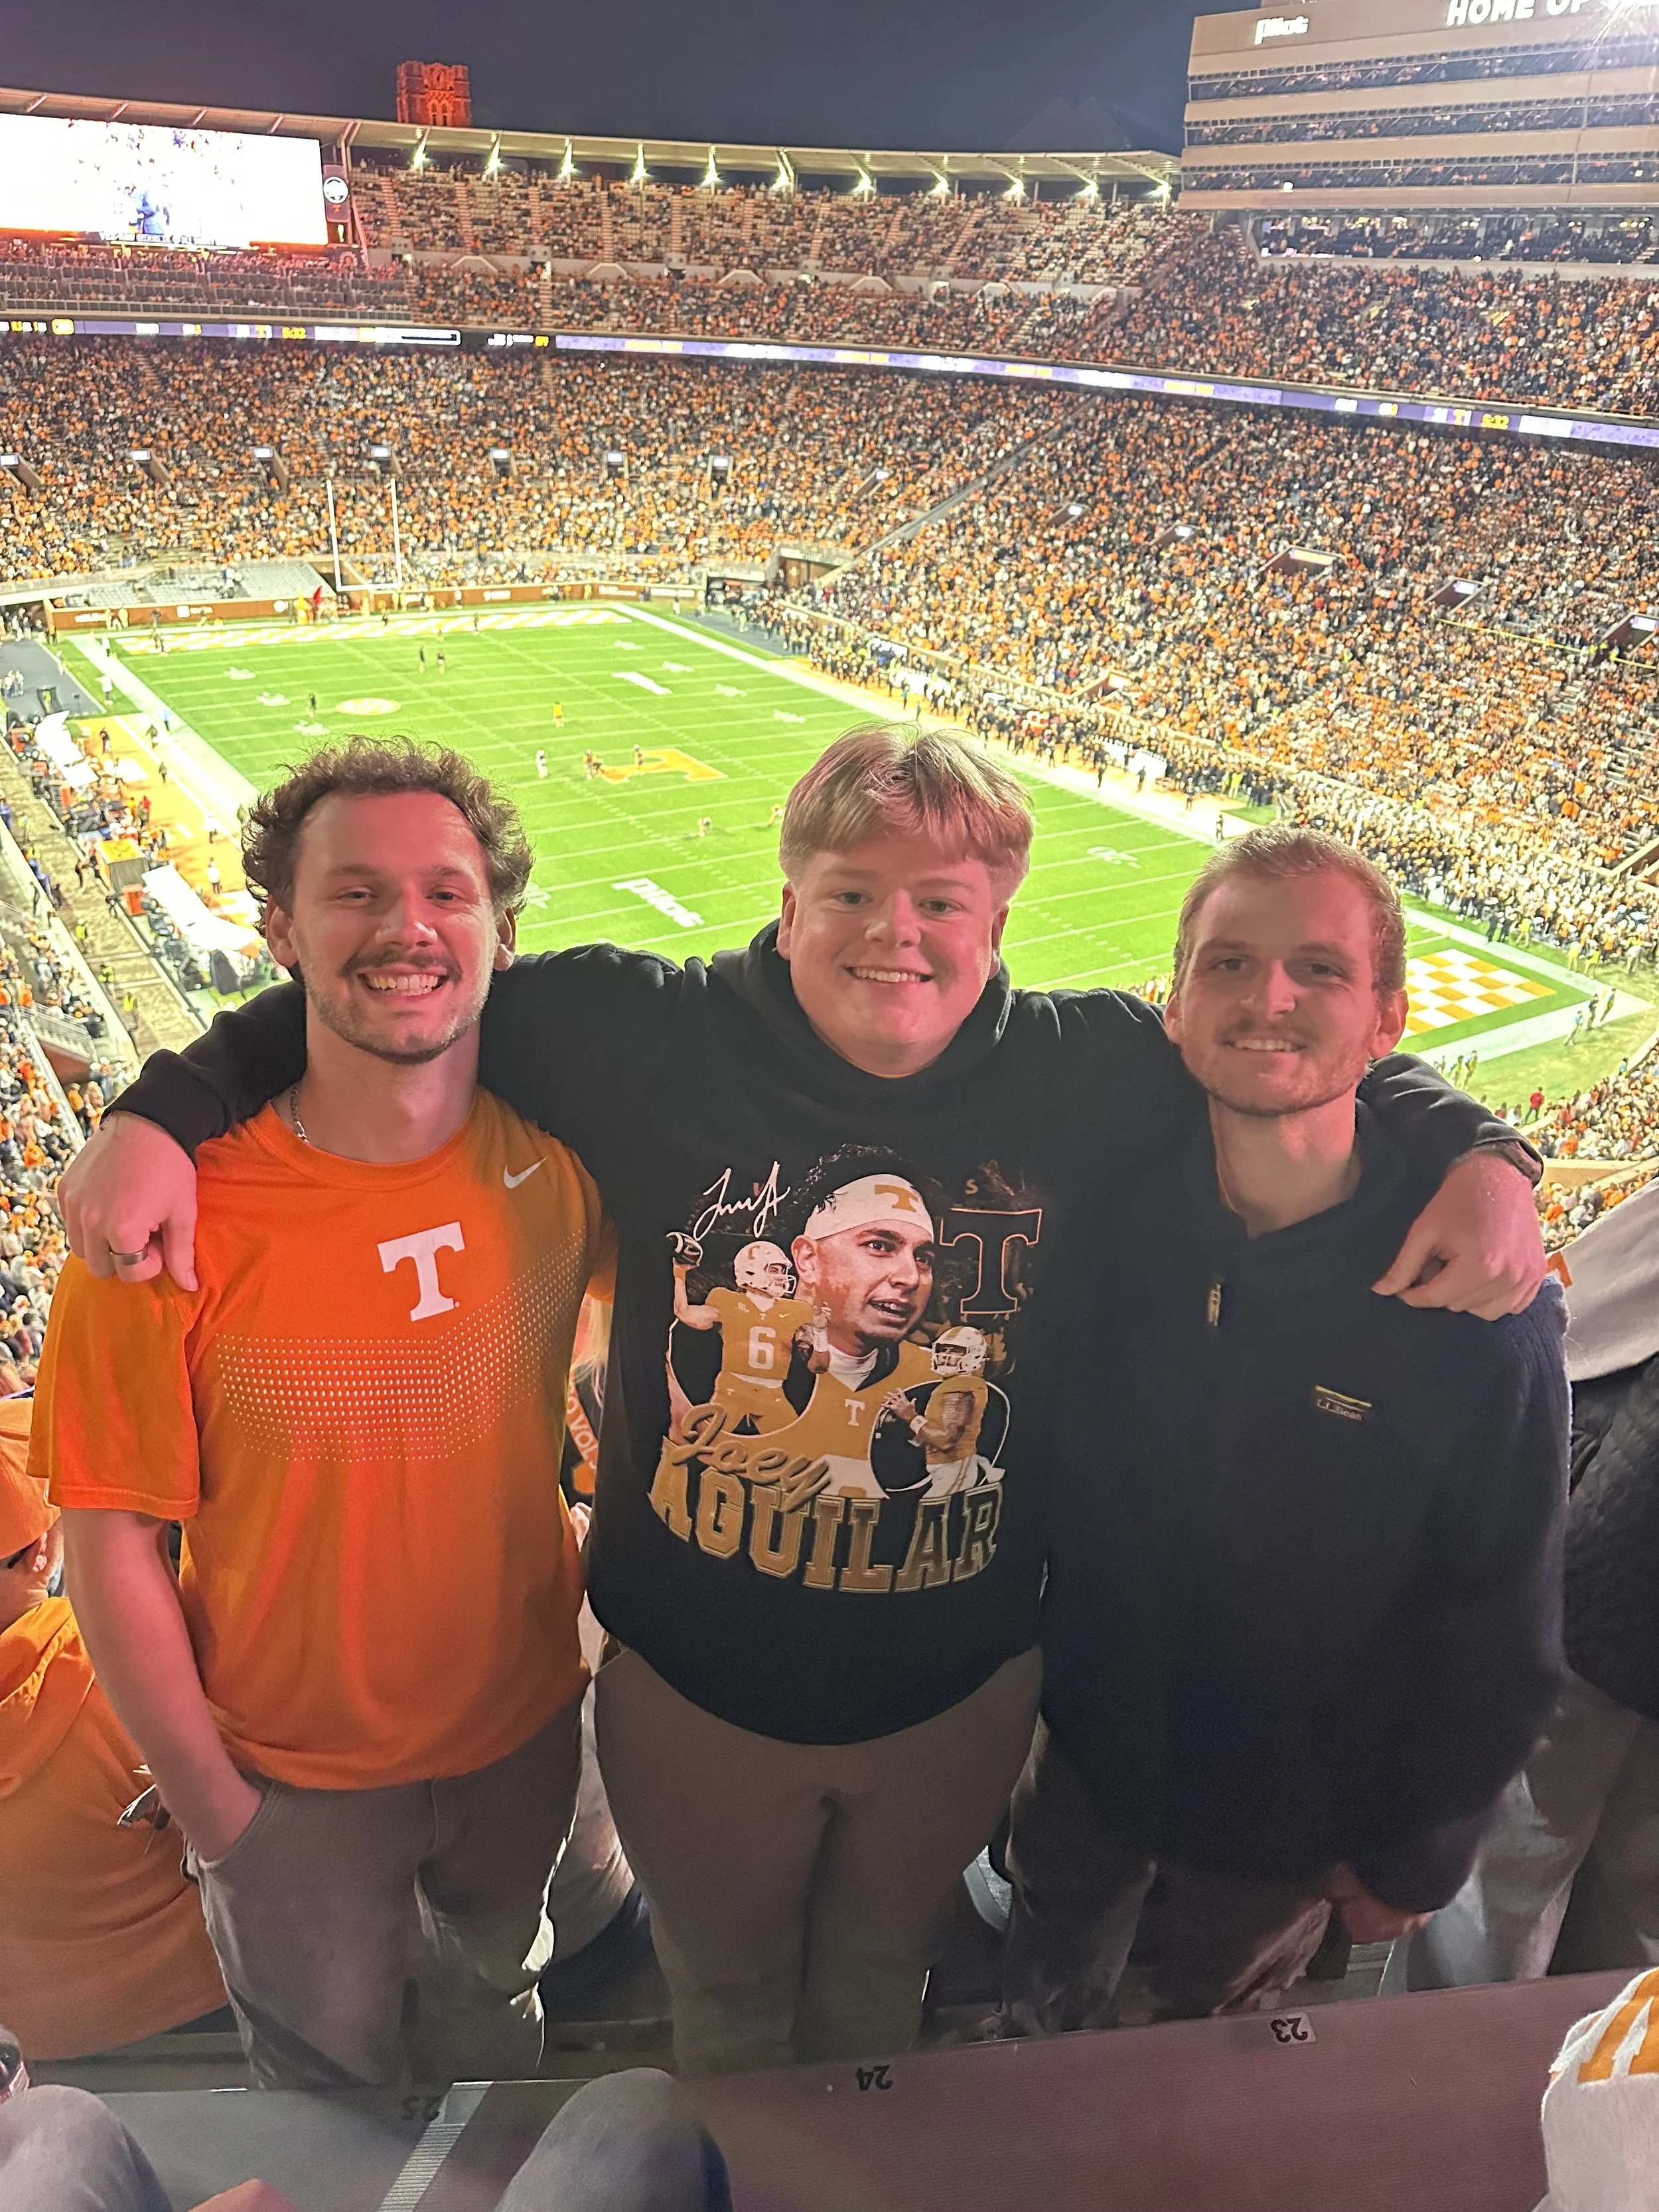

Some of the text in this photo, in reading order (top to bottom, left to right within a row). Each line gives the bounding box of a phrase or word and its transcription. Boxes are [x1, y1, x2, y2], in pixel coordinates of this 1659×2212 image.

[1445, 0, 1534, 27] HOME
[377, 1221, 465, 1322] T
[939, 1209, 1043, 1315] T
[749, 1325, 776, 1370] 6
[845, 1398, 866, 1426] T
[672, 1402, 831, 1514] Joey
[647, 1435, 1003, 1593] AGUILAR
[1270, 2018, 1308, 2043] 23
[855, 2065, 893, 2091] 24
